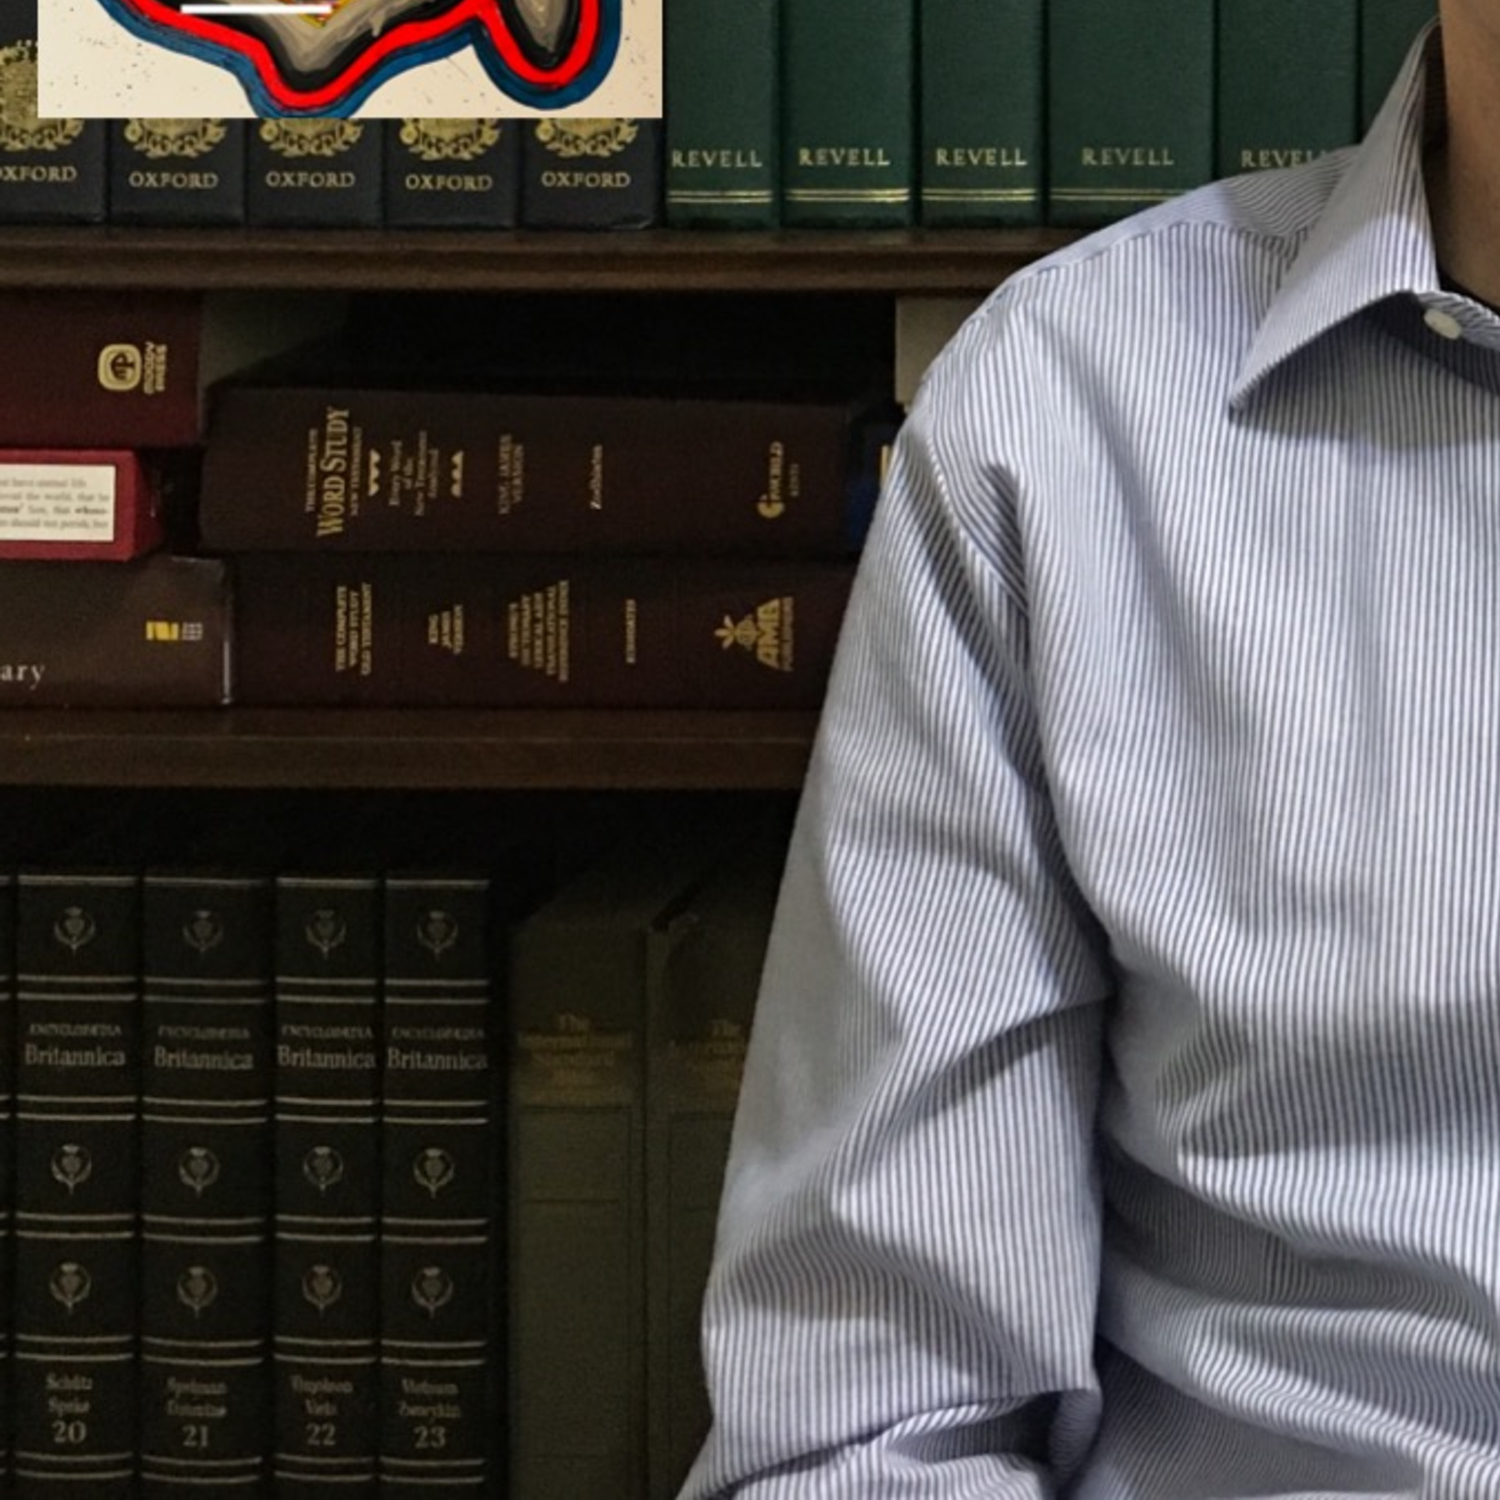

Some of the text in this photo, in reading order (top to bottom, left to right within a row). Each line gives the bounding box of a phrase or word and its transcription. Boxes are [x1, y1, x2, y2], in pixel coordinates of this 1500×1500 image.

[799, 148, 891, 167] REVELL
[1082, 147, 1174, 166] REVELL
[540, 170, 632, 188] OXFORD
[316, 406, 349, 536] WORD STUDY
[24, 1044, 126, 1069] Britannica
[387, 1046, 488, 1071] Britannica
[52, 1422, 86, 1444] 20
[414, 1425, 445, 1447] 23
